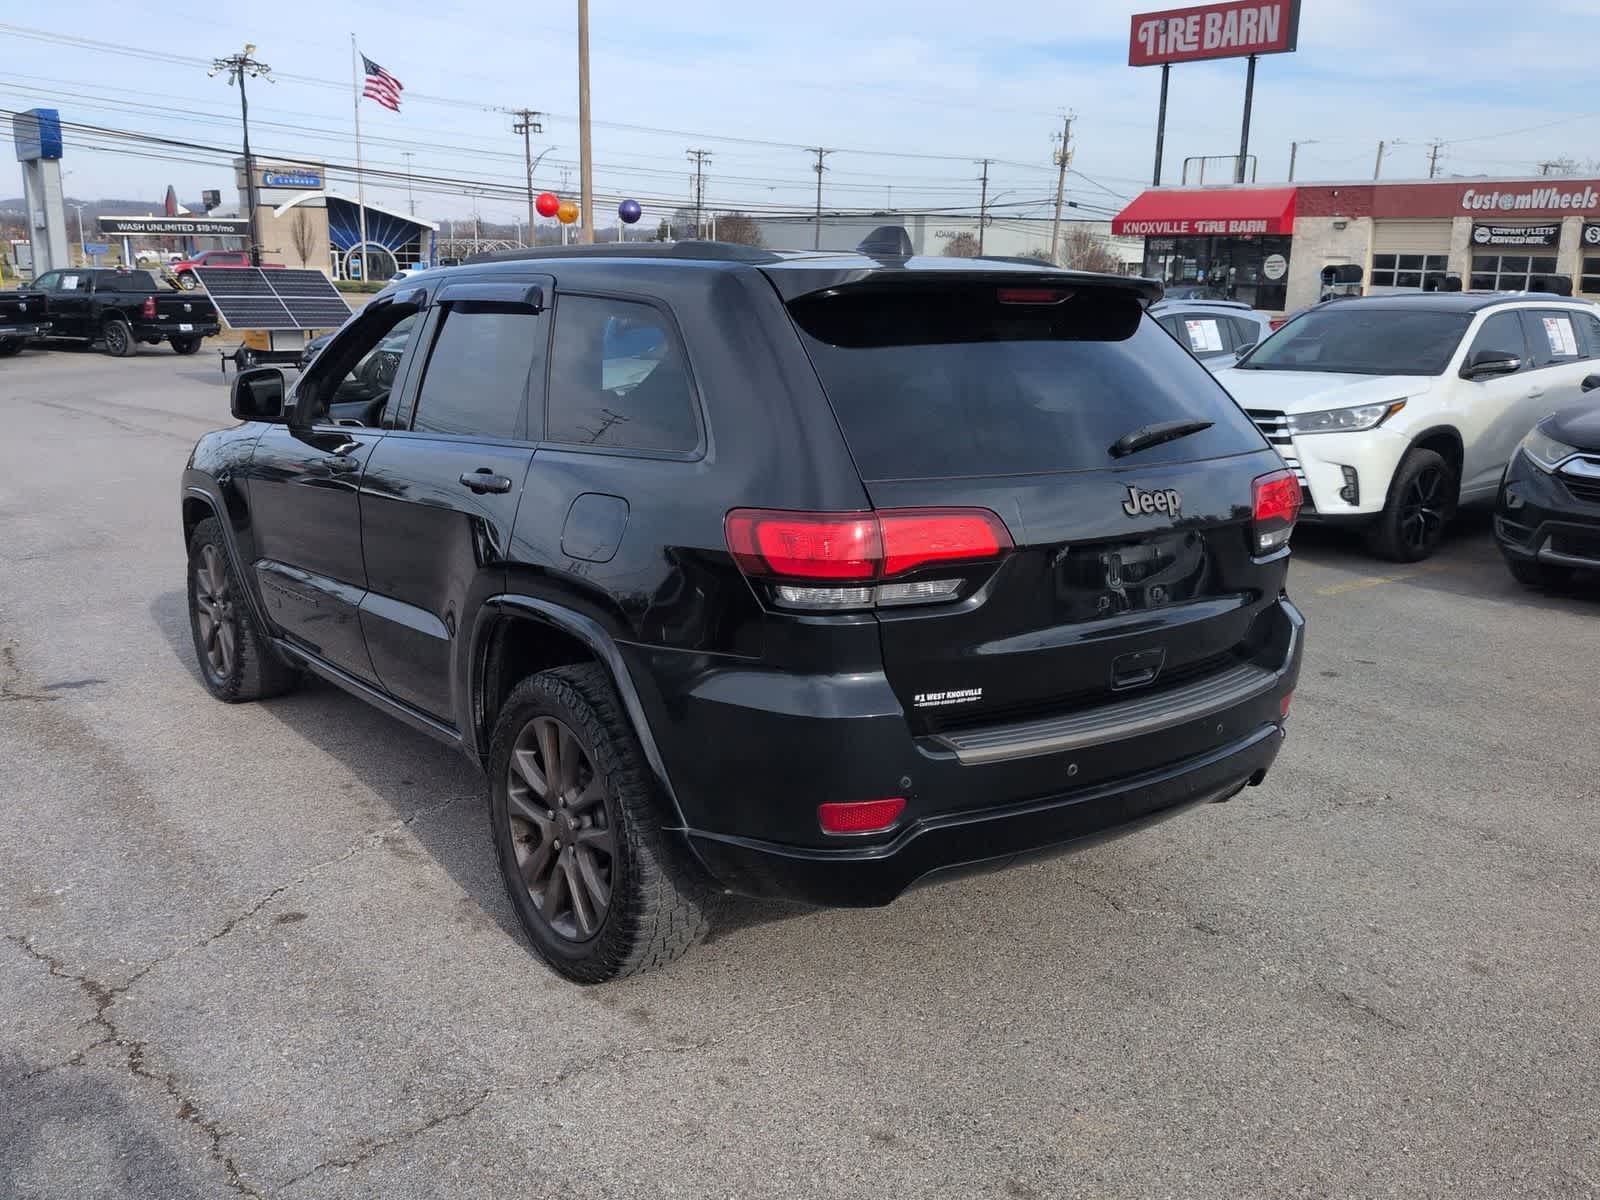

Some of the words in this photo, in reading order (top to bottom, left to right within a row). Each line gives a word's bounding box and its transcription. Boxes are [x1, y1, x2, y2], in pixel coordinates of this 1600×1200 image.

[1203, 5, 1281, 49] BARN
[117, 223, 145, 231] WASH
[146, 223, 195, 232] UNLIMITED
[1123, 221, 1189, 233] KNOXVILLE
[1229, 220, 1267, 233] BARN
[1490, 236, 1525, 244] SERVICED
[1122, 486, 1181, 518] Jeep
[915, 694, 926, 702] #1
[926, 692, 946, 700] WEST
[946, 688, 982, 699] KNOXVILLE
